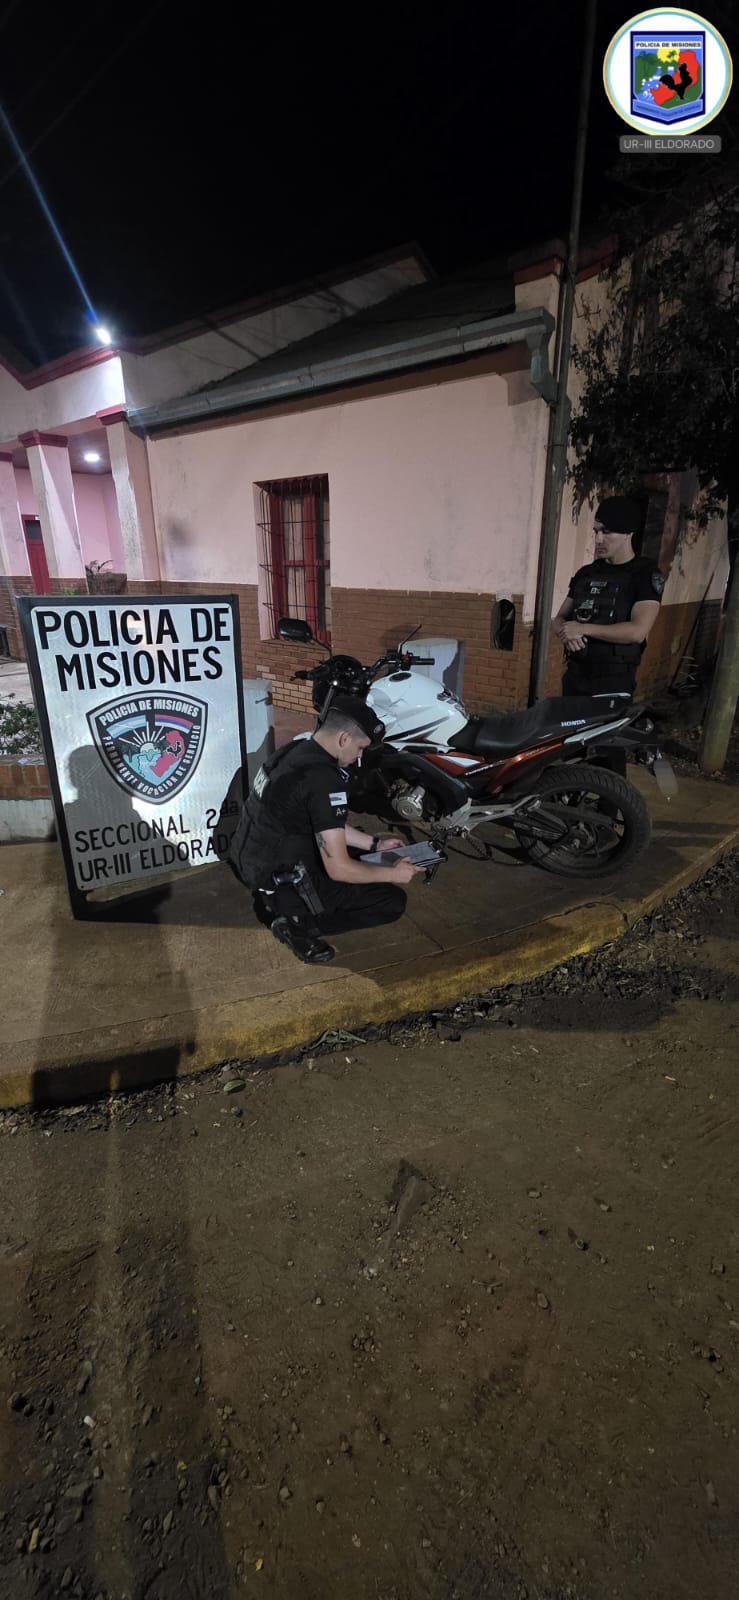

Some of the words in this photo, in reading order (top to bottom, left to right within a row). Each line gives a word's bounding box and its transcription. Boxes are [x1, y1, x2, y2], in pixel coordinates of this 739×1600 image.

[36, 608, 179, 649] POLICIA
[191, 607, 231, 642] DE
[55, 645, 223, 692] MISIONES
[98, 704, 138, 726] POLICIA
[138, 699, 152, 711] DE
[153, 699, 200, 718] MISIONES
[561, 719, 586, 727] HONDA
[137, 776, 178, 796] VOCACION
[175, 765, 186, 777] DE
[182, 724, 201, 764] SERVICIO
[74, 814, 190, 852] SECCIONAL
[78, 852, 131, 882] UR-III
[139, 832, 235, 870] ELDORAD
